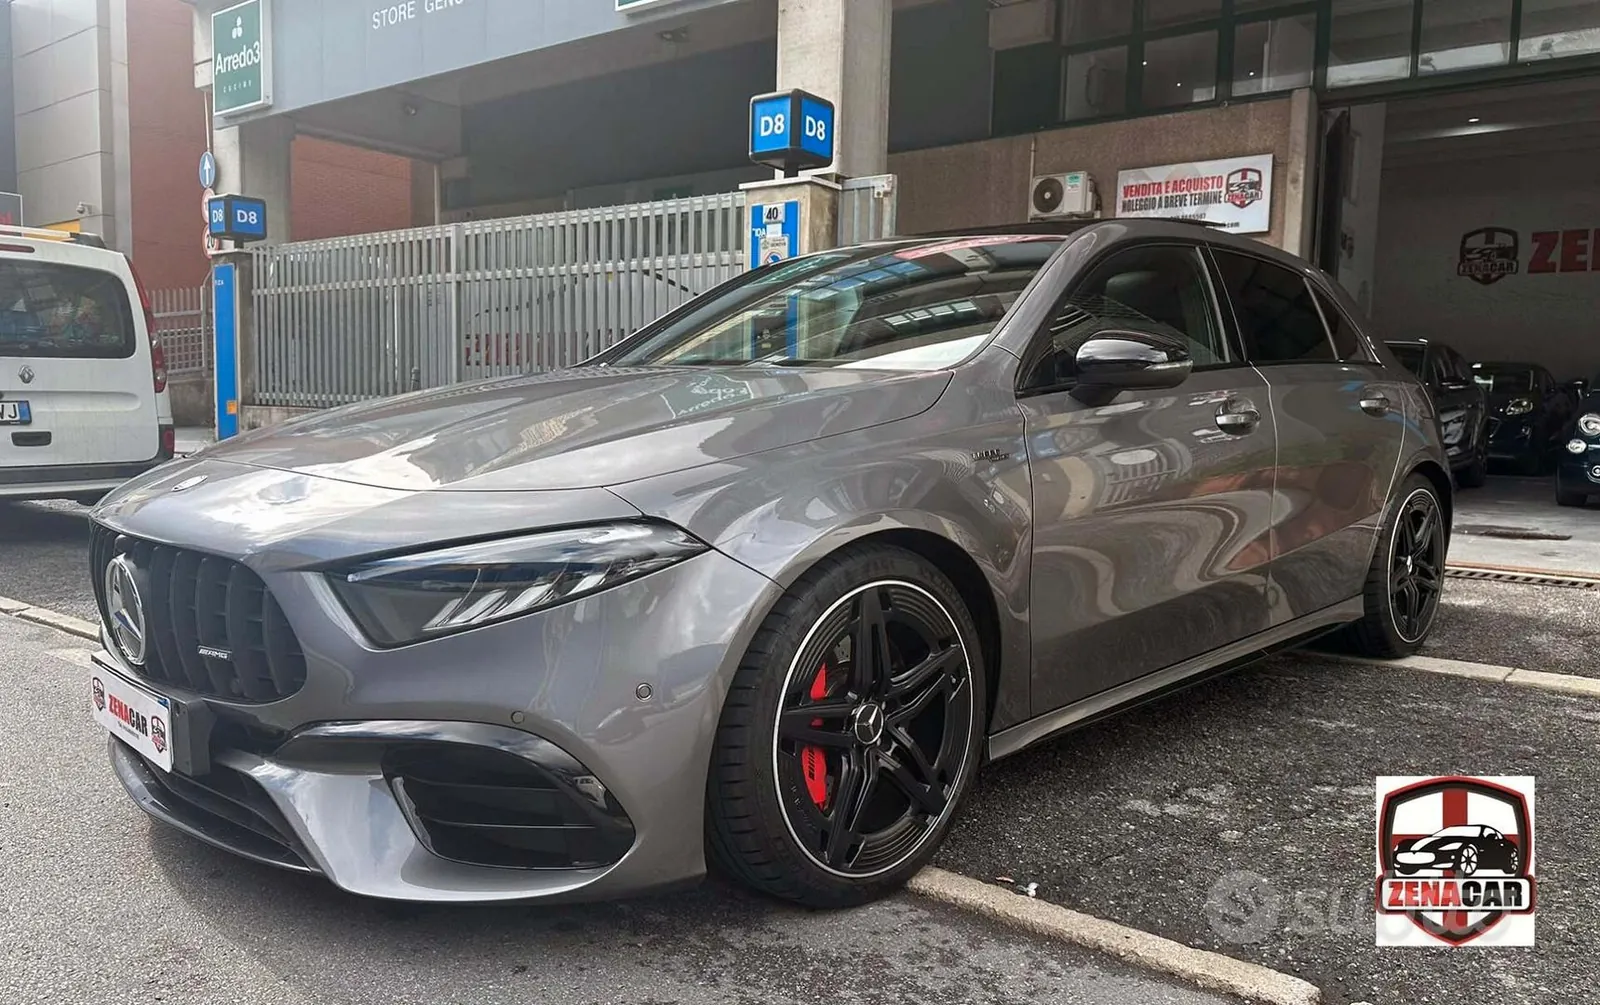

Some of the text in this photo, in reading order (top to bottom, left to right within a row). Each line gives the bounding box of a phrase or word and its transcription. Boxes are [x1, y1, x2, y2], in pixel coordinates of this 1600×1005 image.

[372, 0, 416, 30] STORE
[214, 40, 260, 76] Arredo3
[760, 113, 785, 137] D8
[805, 115, 826, 141] D8
[1123, 175, 1223, 199] VENDITA E ACQUISTO
[766, 207, 779, 220] 40
[1122, 196, 1157, 213] NOLEGGIO
[1164, 193, 1187, 209] BREVE
[1189, 190, 1223, 206] TERMINE
[212, 209, 224, 223] D8
[236, 209, 258, 224] D8
[1527, 228, 1600, 274] ZE
[108, 694, 149, 737] ZENACAR
